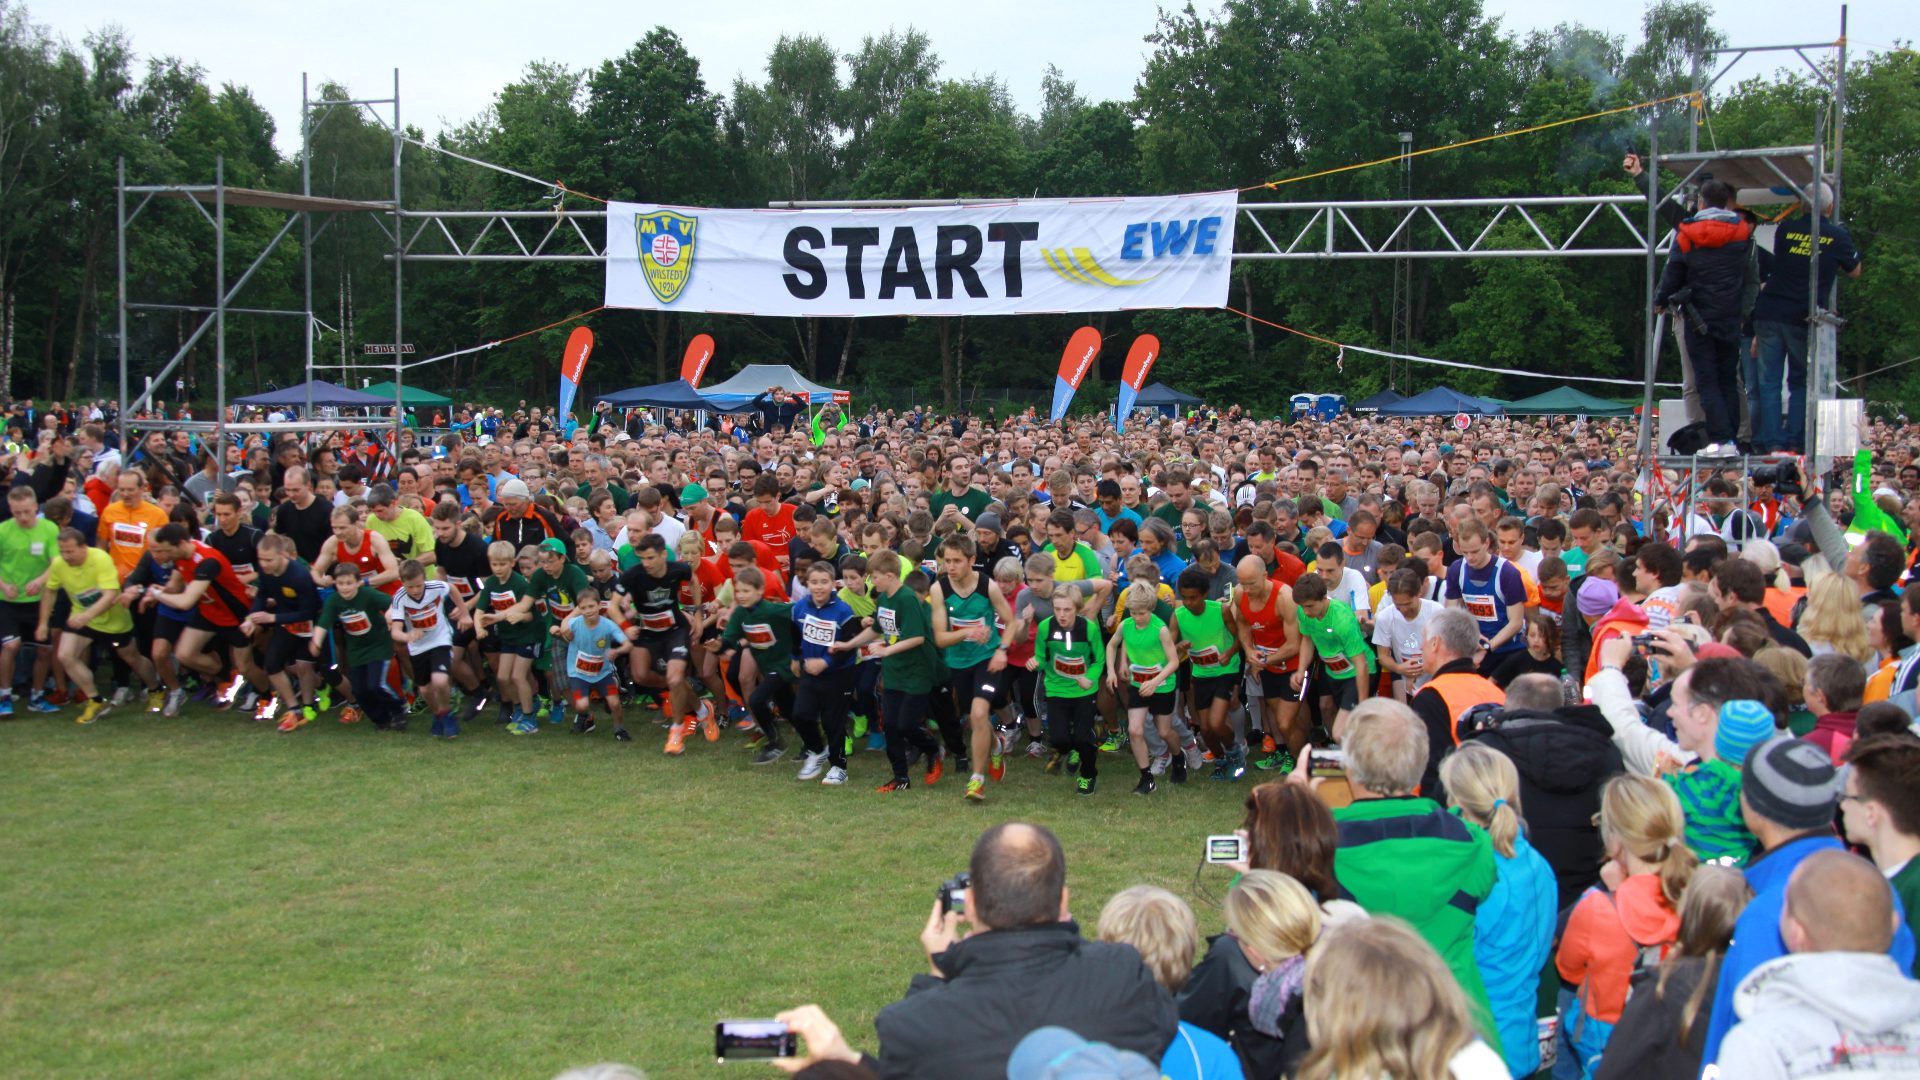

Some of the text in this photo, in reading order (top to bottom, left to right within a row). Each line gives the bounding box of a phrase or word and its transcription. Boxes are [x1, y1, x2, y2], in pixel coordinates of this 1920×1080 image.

[1120, 216, 1222, 260] EWE
[1786, 233, 1834, 245] WILSDT
[1789, 246, 1822, 256] NAC
[782, 221, 1040, 300] START
[651, 269, 684, 281] WILSTEDT
[659, 281, 675, 292] 1920
[365, 345, 415, 353] HEIDEAD
[572, 344, 588, 382] dodenhof
[691, 350, 709, 386] dodenhof
[1071, 346, 1094, 386] dodenhof
[1133, 352, 1152, 389] dodenhof
[805, 624, 833, 642] 4365
